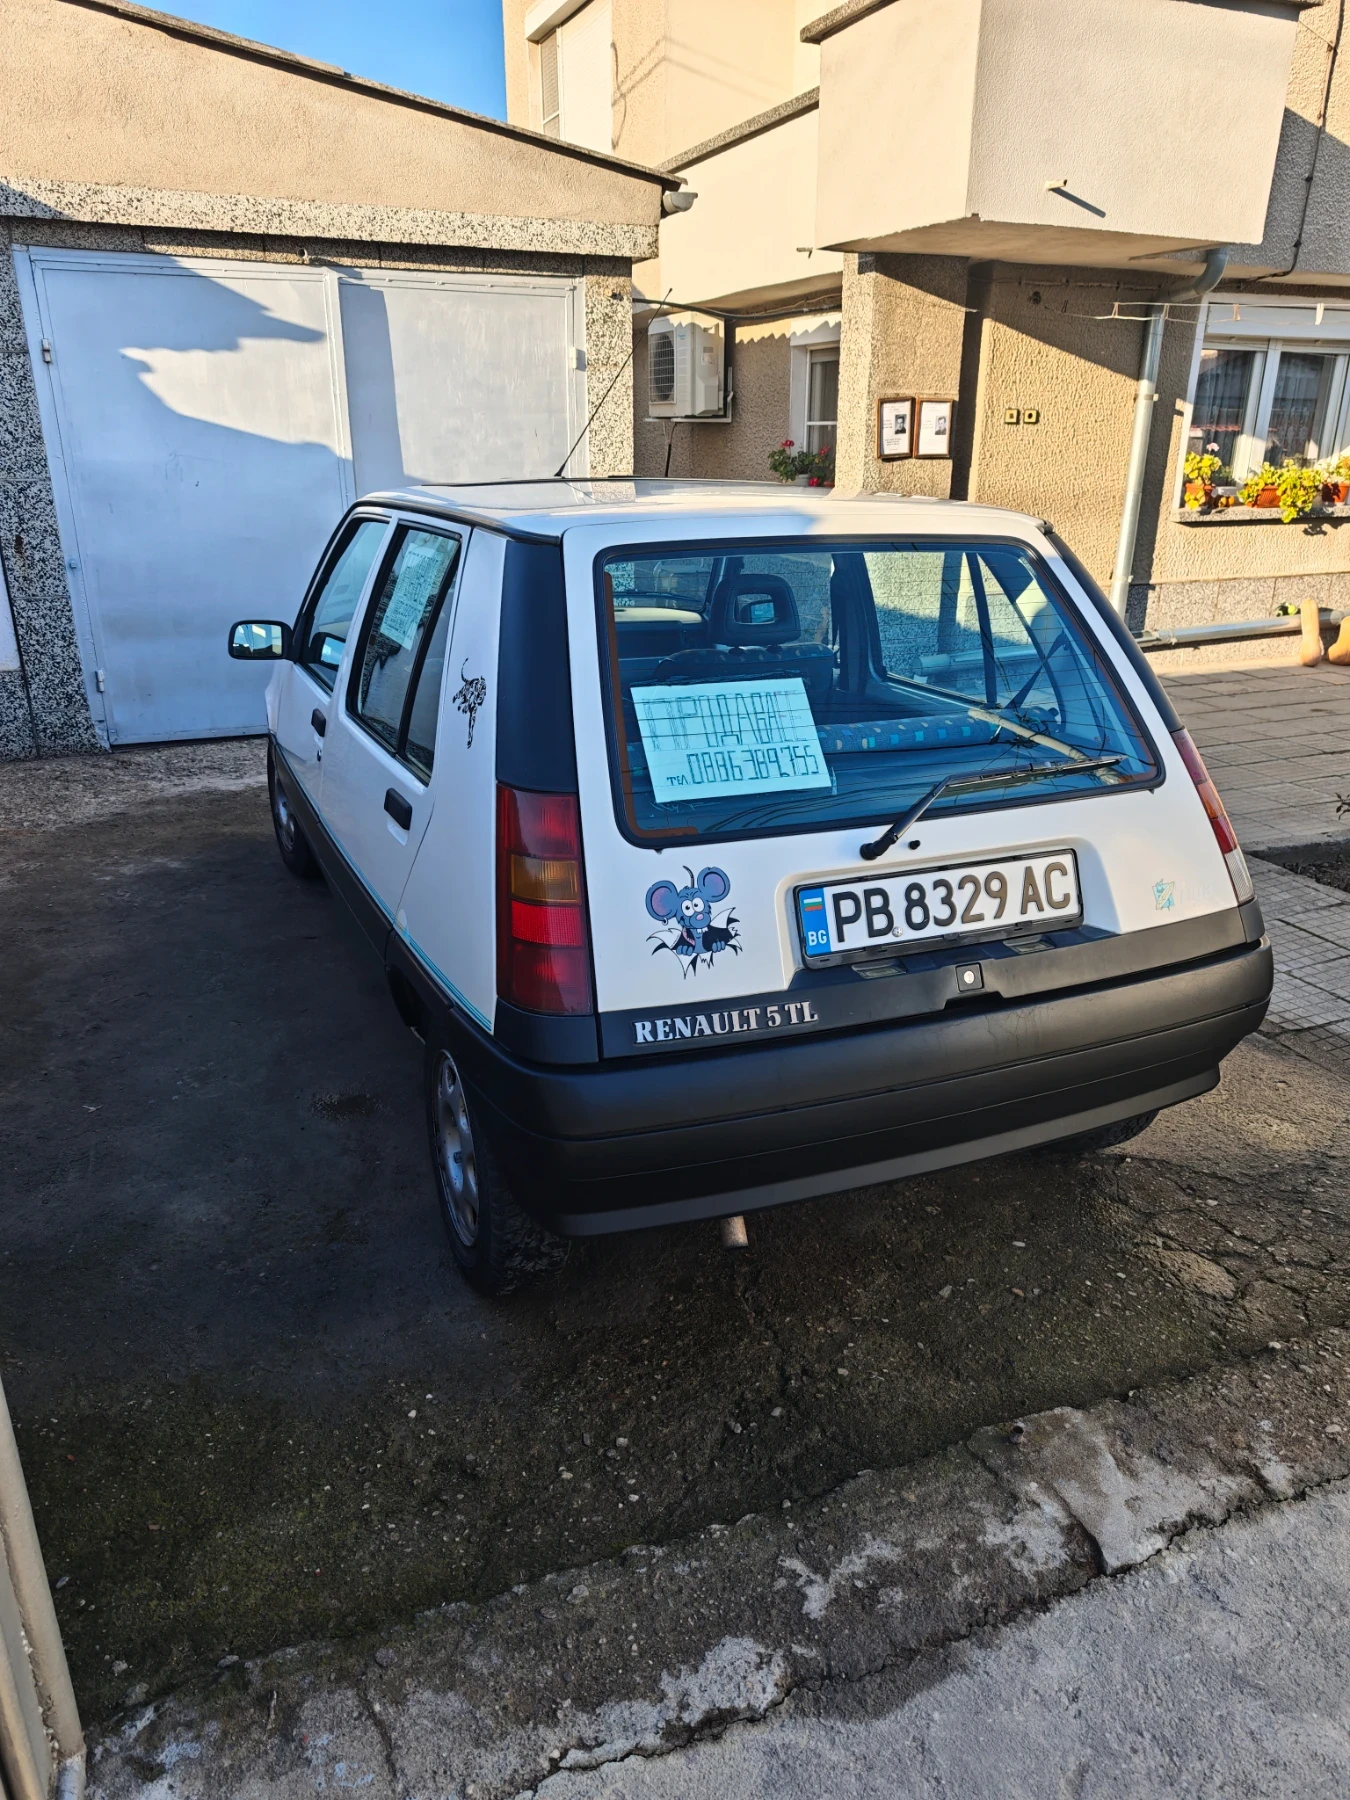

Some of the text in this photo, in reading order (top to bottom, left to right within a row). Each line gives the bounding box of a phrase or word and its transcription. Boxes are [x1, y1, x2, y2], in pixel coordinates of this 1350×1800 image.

[832, 861, 1071, 943] PB 8329 AC
[807, 929, 828, 947] BG
[634, 1001, 819, 1044] RENAULT 5 TL
